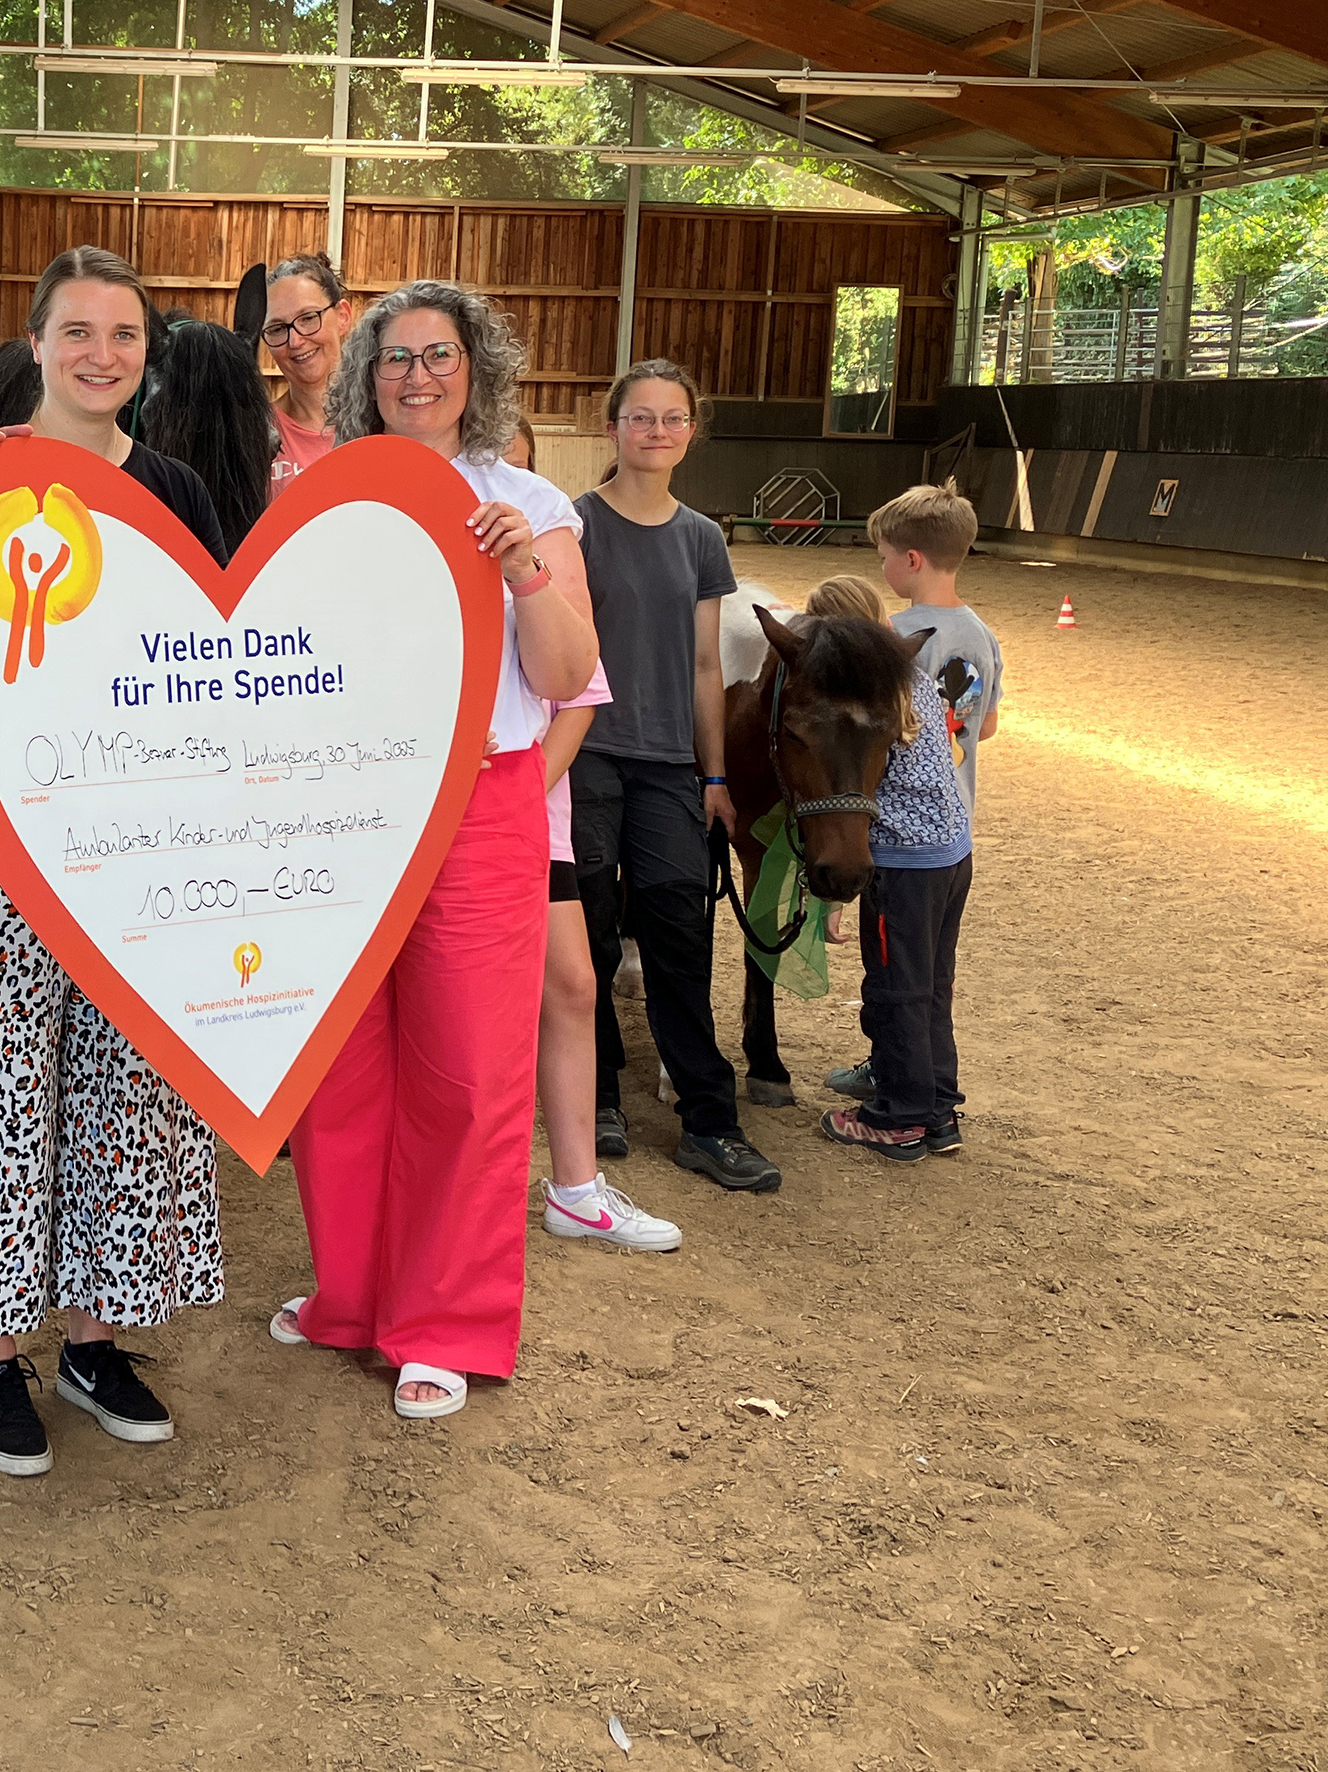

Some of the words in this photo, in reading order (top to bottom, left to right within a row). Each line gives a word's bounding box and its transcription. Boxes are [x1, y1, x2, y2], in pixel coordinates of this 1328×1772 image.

[1153, 483, 1176, 513] M
[140, 631, 233, 663] Vielen
[243, 626, 314, 658] Dank
[111, 676, 155, 707] für
[166, 673, 223, 703] Ihre
[234, 664, 344, 705] Spende!
[244, 777, 257, 785] Ort,
[259, 775, 280, 784] Datum
[20, 794, 51, 806] Spender
[62, 822, 162, 861] Ambulanter
[64, 863, 103, 874] Empfänger
[121, 933, 148, 944] Summe
[184, 997, 245, 1014] Ökumenische
[246, 986, 315, 1005] Hospizinitiative
[195, 1017, 206, 1027] im
[206, 1012, 244, 1025] Landkreis
[244, 1004, 292, 1020] Ludwigsburg
